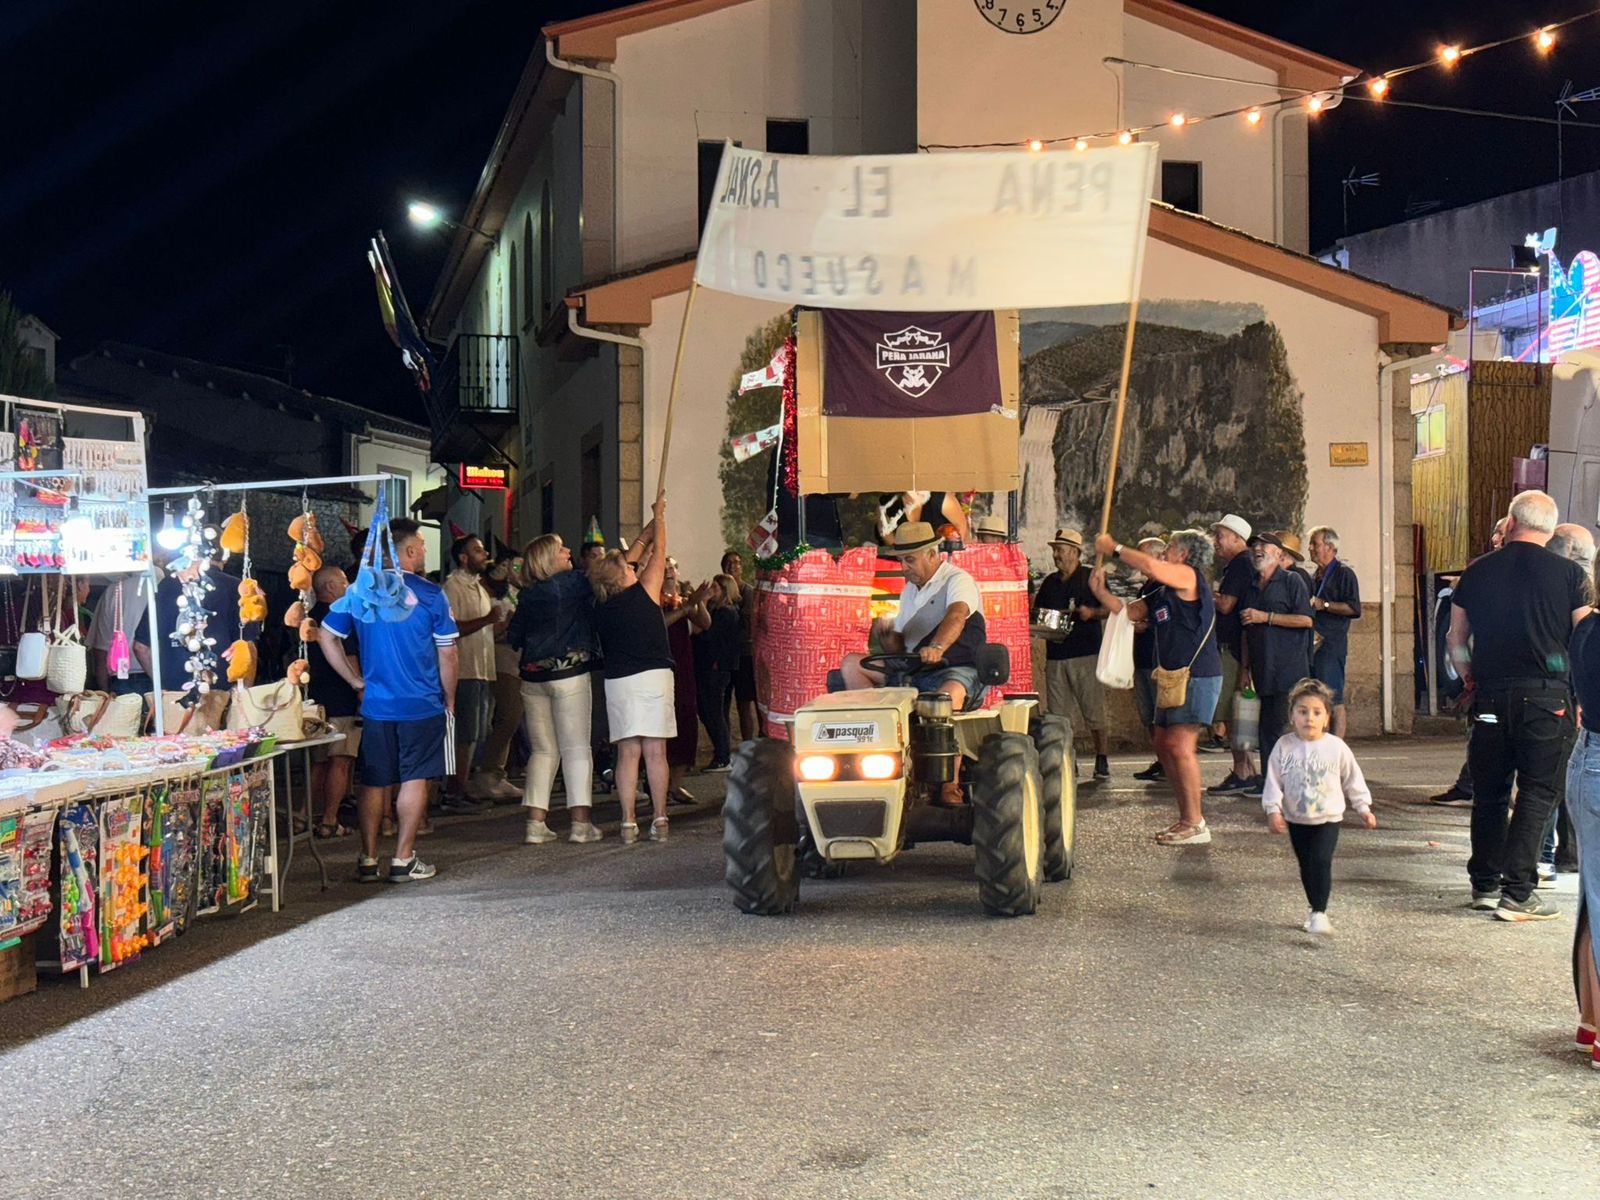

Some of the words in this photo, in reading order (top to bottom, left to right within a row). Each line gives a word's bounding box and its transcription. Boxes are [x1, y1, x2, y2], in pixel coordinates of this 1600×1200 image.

[986, 0, 994, 10] 8
[999, 9, 1007, 21] 7
[1016, 13, 1025, 27] 6
[1032, 9, 1042, 22] 5
[835, 725, 874, 739] pasquali
